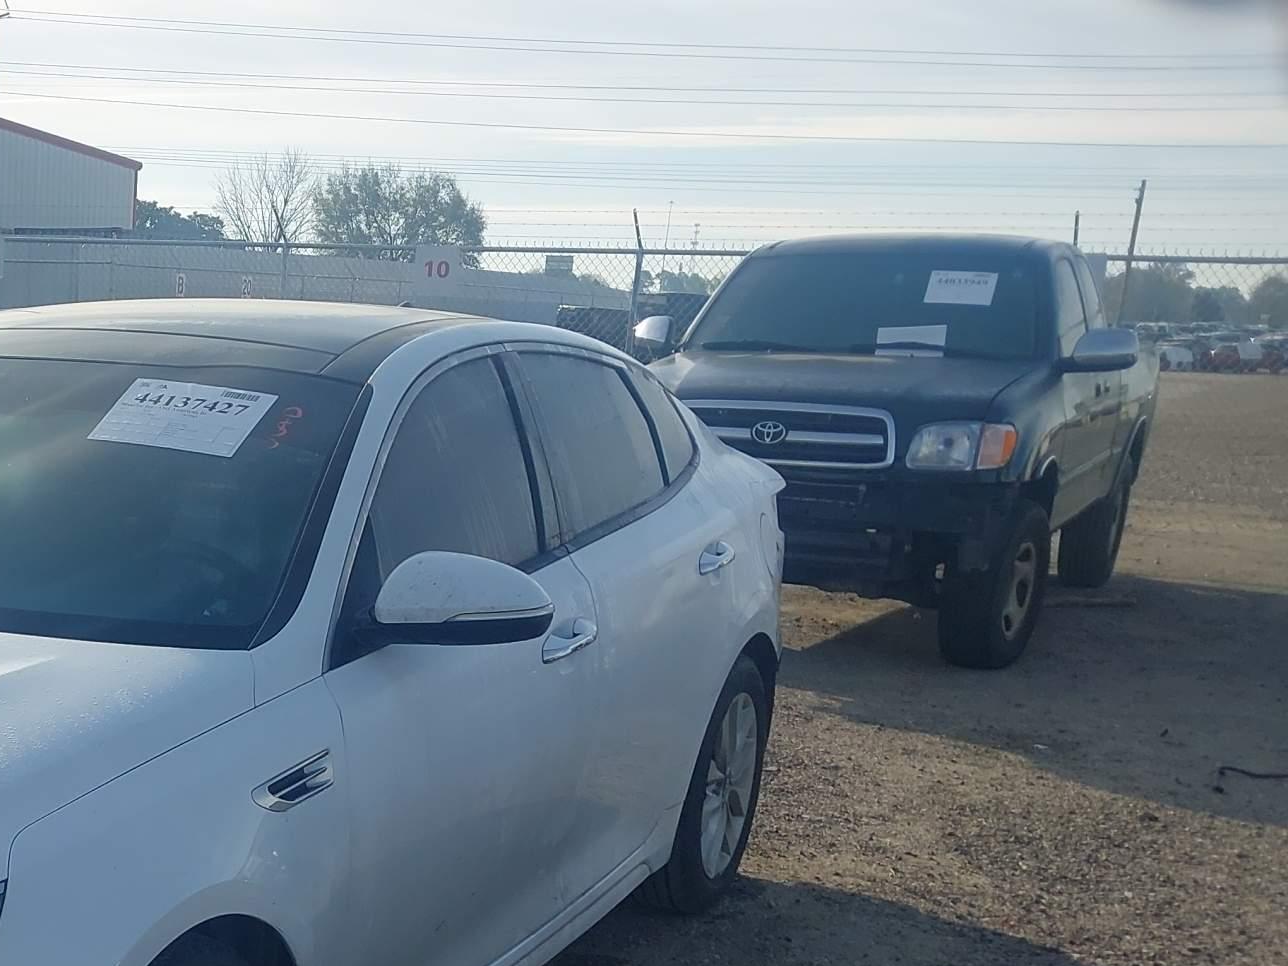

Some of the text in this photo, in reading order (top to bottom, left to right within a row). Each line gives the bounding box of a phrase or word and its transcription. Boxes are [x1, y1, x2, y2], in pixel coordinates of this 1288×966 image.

[424, 260, 450, 278] 10
[177, 276, 184, 294] B
[134, 391, 250, 416] 44137427
